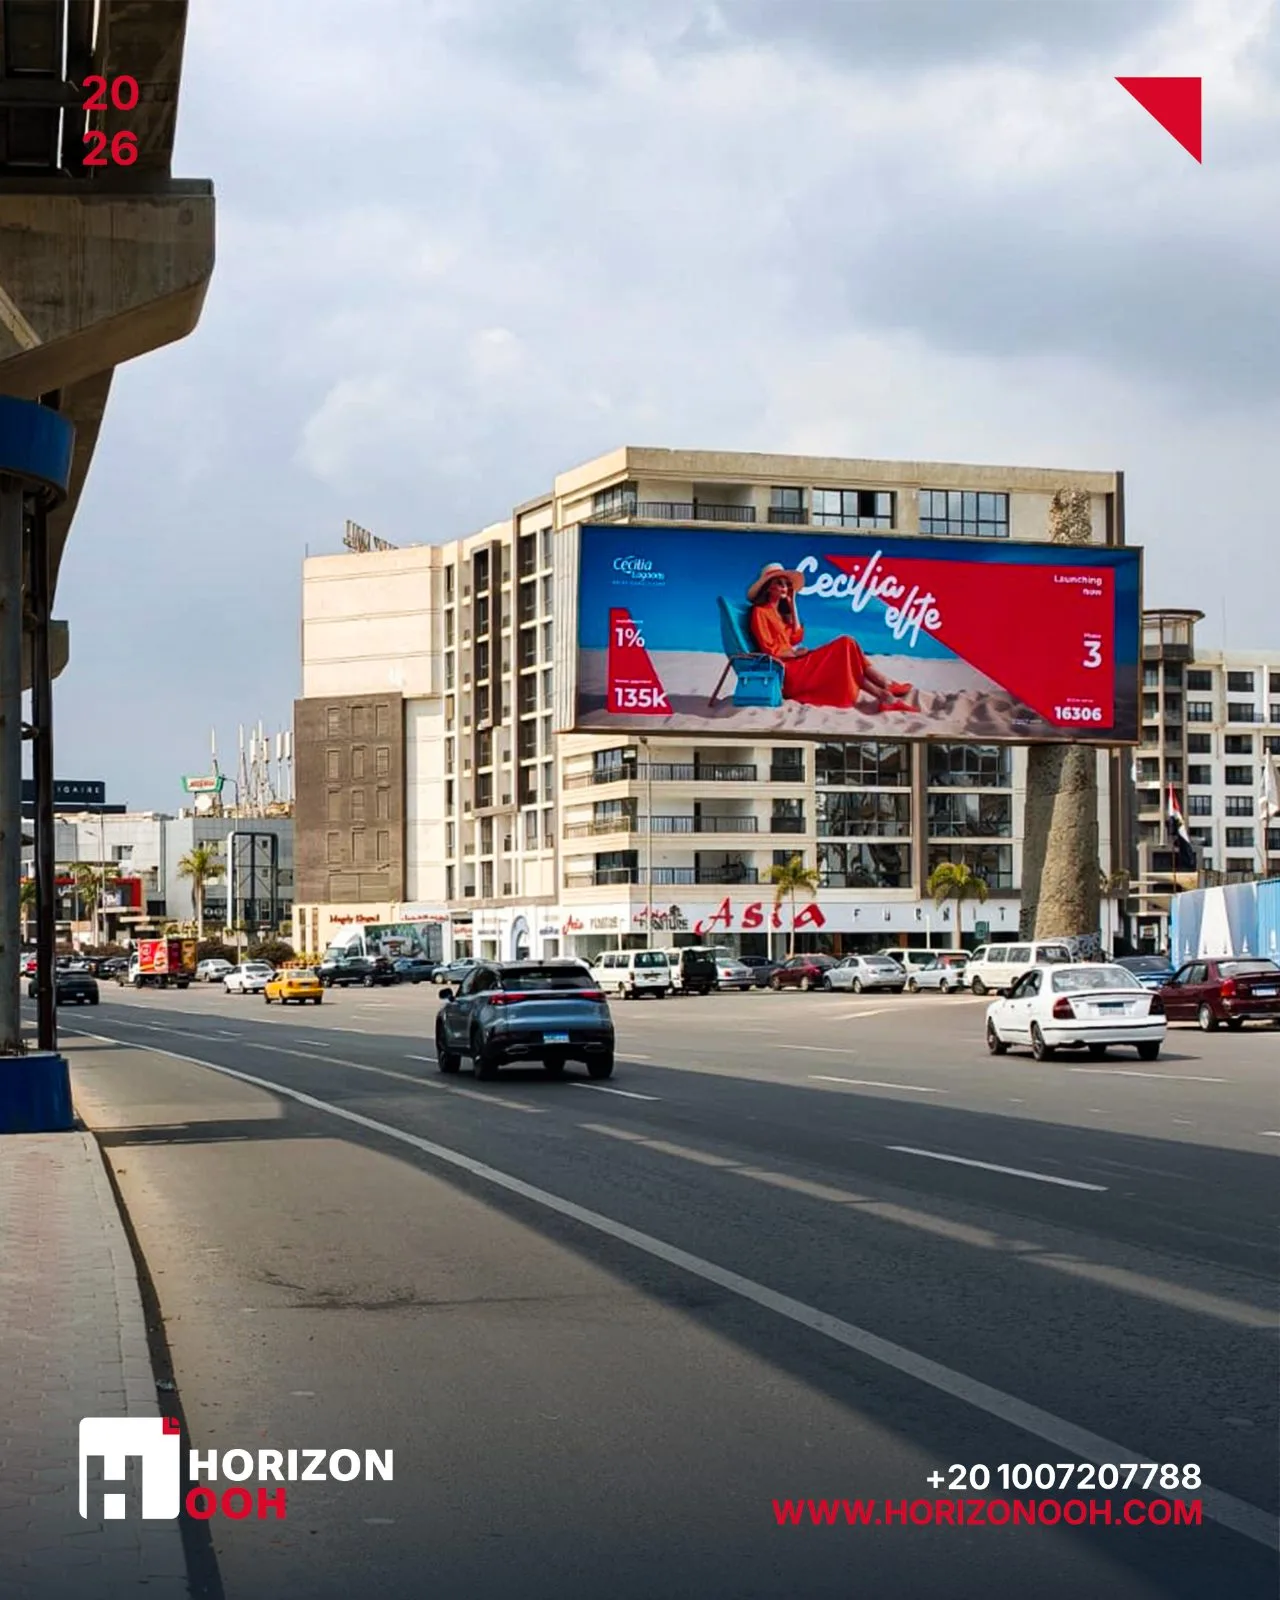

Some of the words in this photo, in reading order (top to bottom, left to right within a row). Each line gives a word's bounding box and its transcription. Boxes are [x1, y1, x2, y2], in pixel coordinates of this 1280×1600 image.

[795, 549, 905, 613] Cecilia
[1053, 574, 1103, 587] Launching
[884, 585, 942, 648] elite
[615, 627, 646, 648] 1%
[1082, 640, 1103, 669] 3
[614, 686, 669, 708] 135k
[1054, 705, 1103, 722] 16306
[693, 896, 827, 937] Asia
